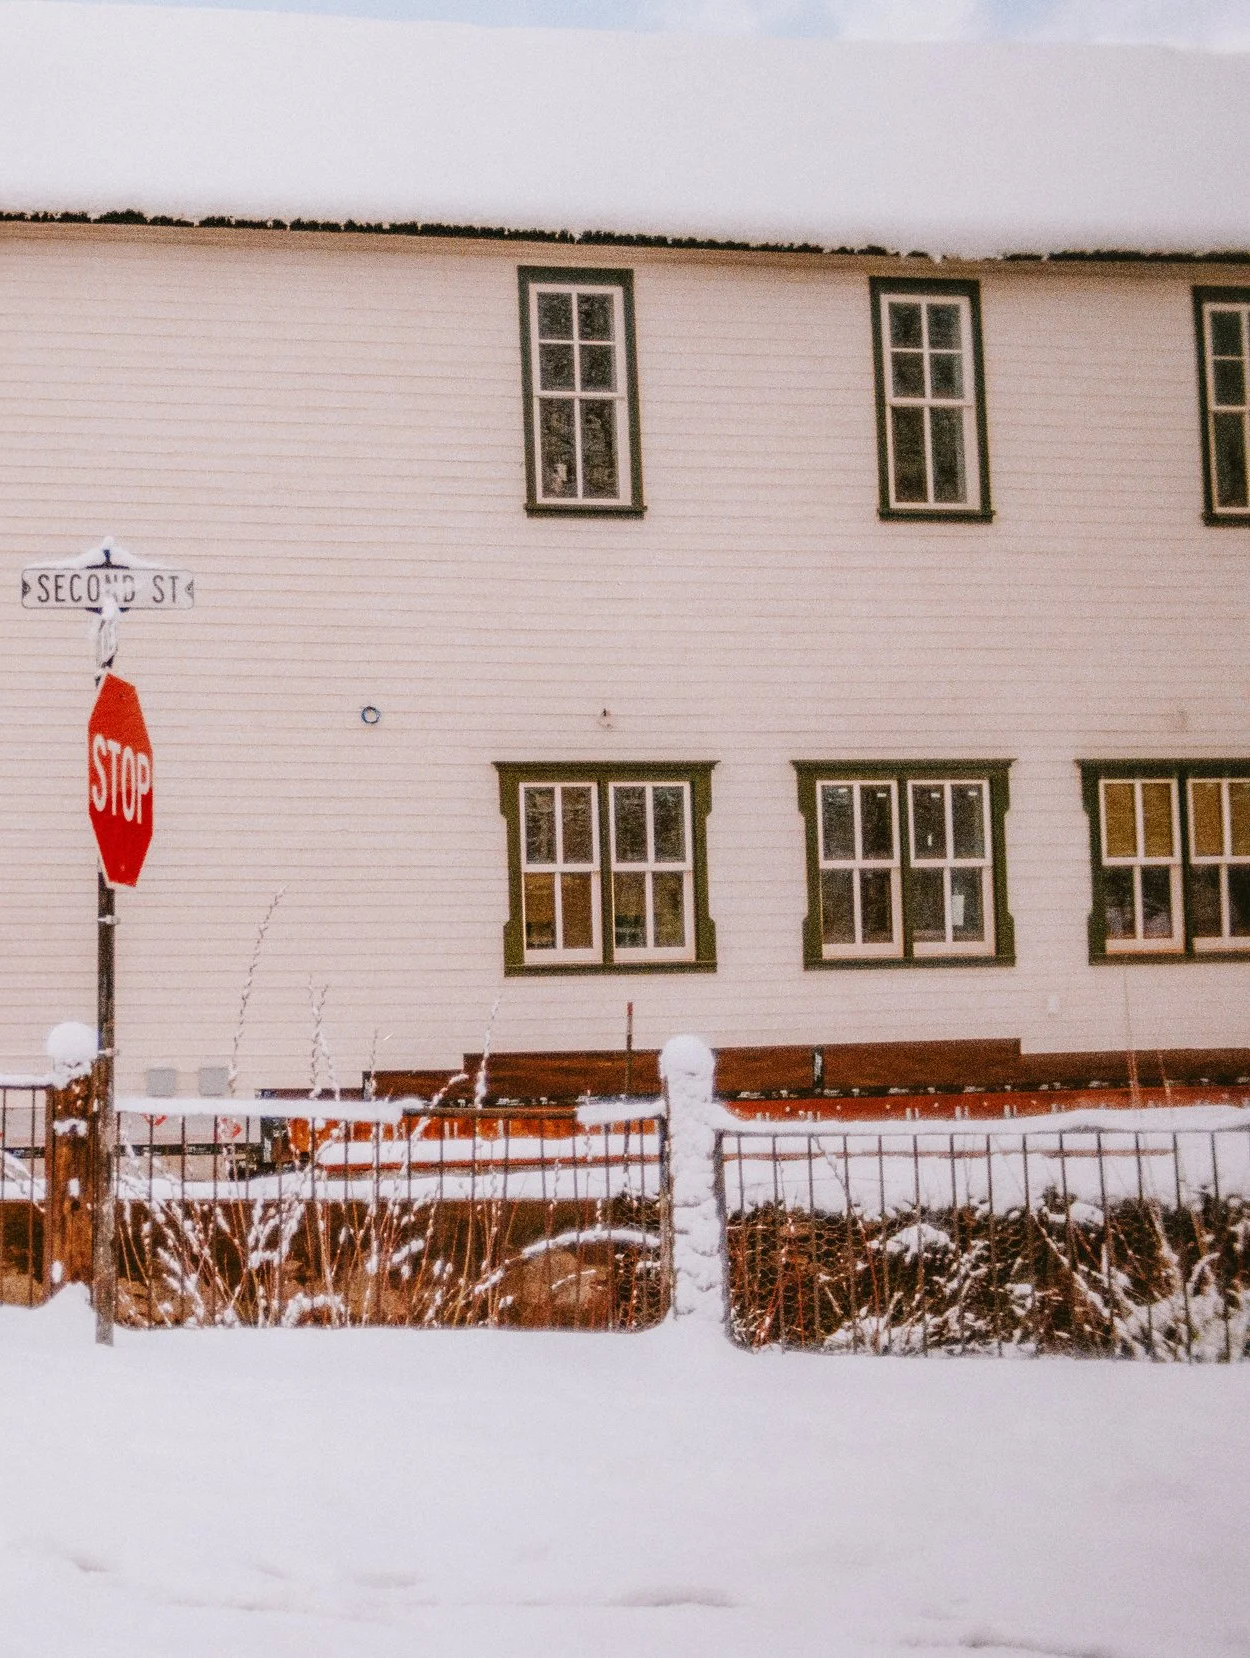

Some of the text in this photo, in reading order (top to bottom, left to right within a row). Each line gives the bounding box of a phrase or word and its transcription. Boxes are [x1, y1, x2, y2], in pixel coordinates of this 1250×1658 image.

[37, 573, 180, 603] SECOND ST
[91, 733, 152, 825] STOP
